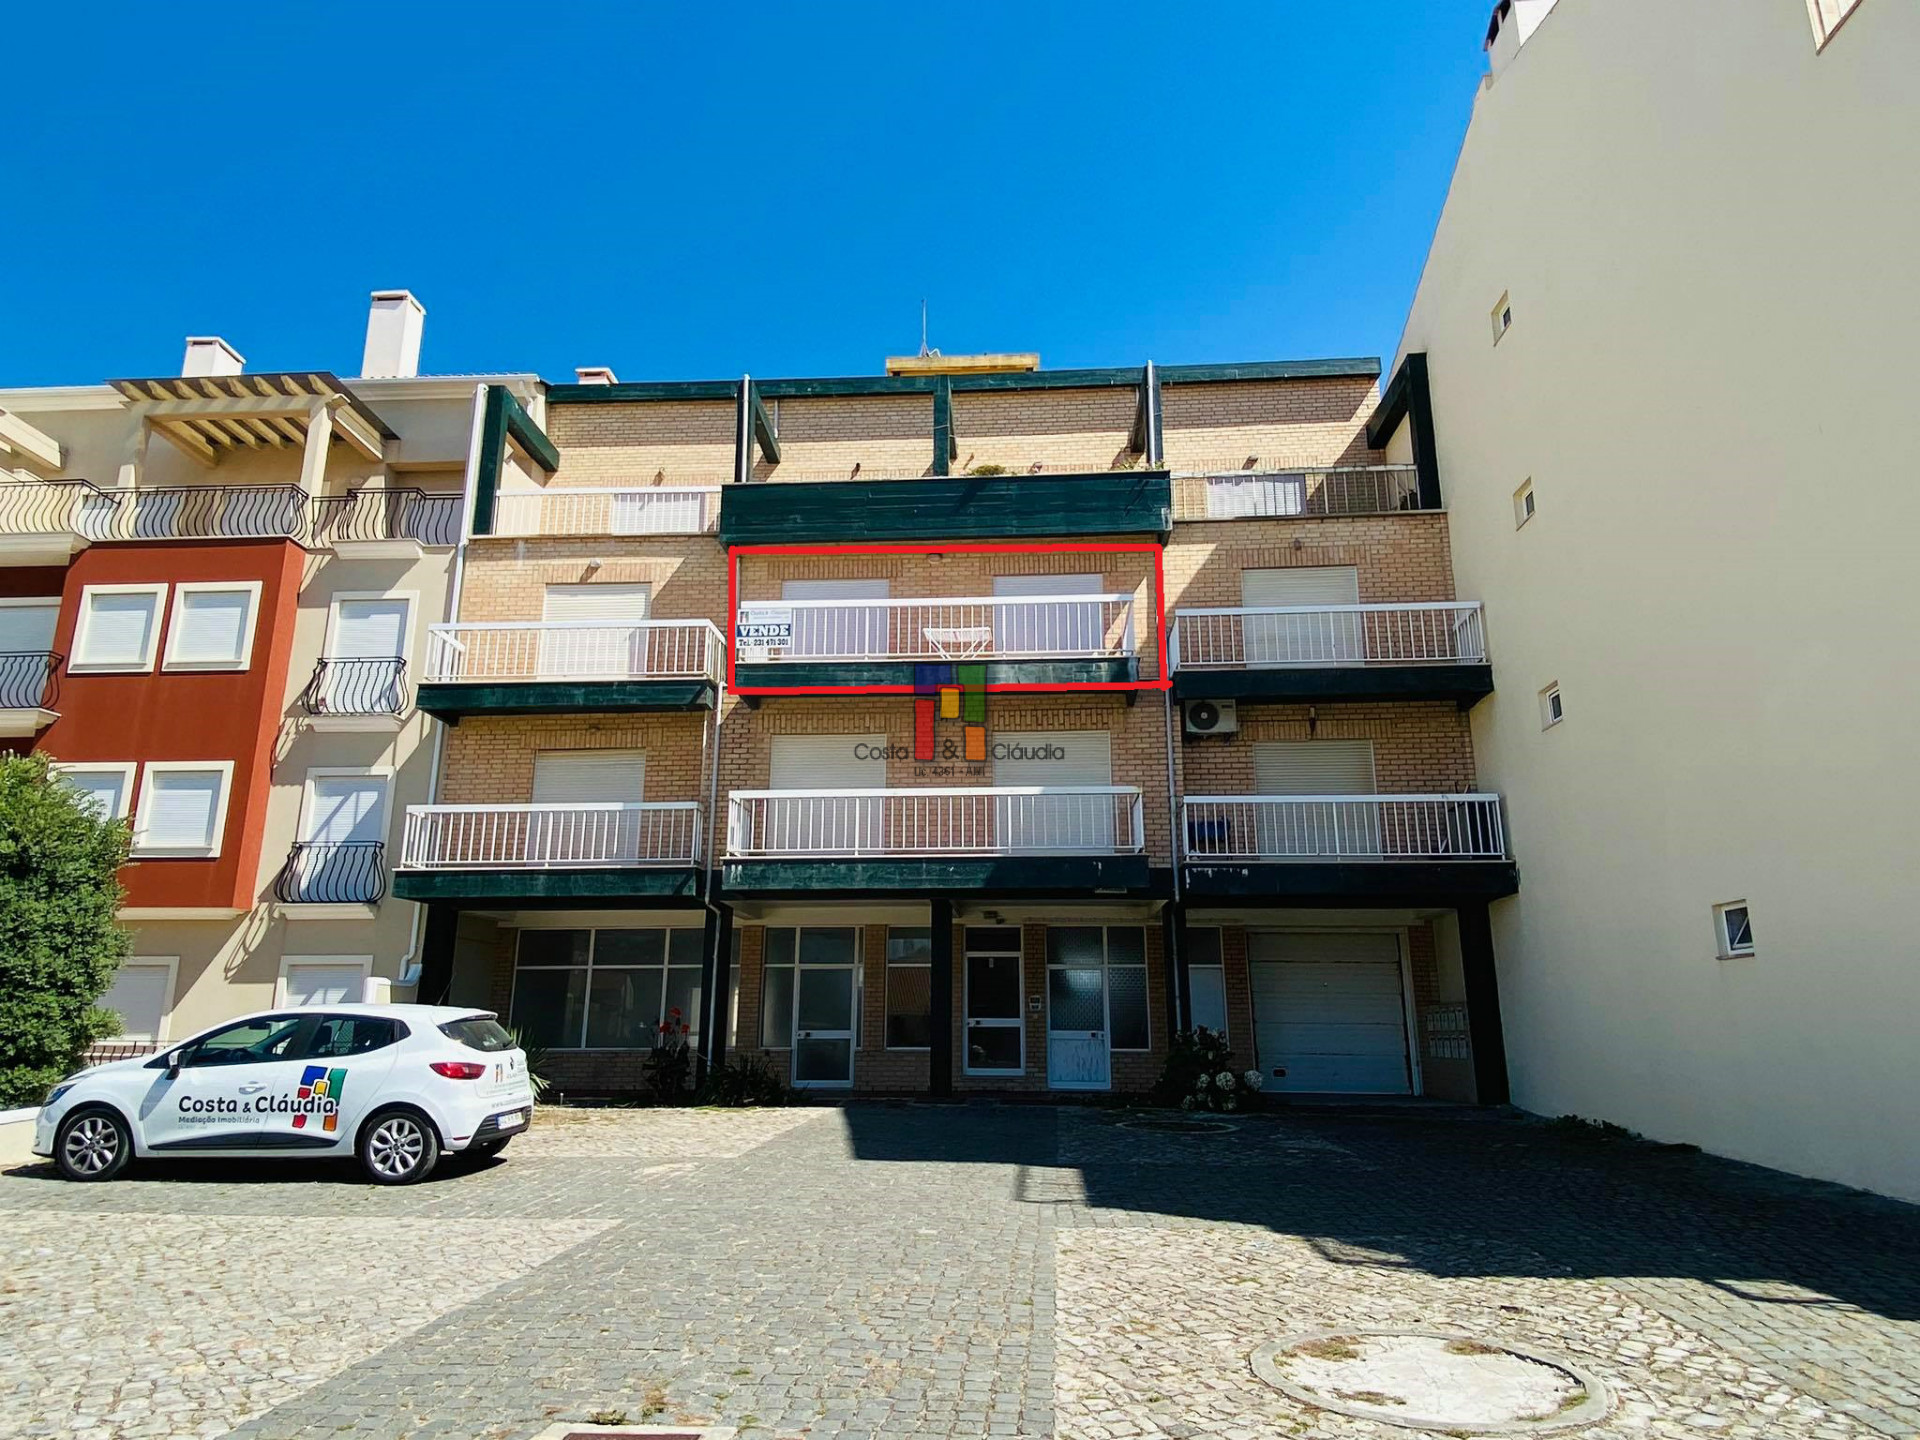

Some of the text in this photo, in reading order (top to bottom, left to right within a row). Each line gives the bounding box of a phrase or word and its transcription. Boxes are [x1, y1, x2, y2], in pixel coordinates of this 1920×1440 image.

[739, 625, 788, 636] VENDE
[178, 1093, 335, 1114] Costa & Cláudia
[178, 1115, 260, 1125] Mediação Imobiliária
